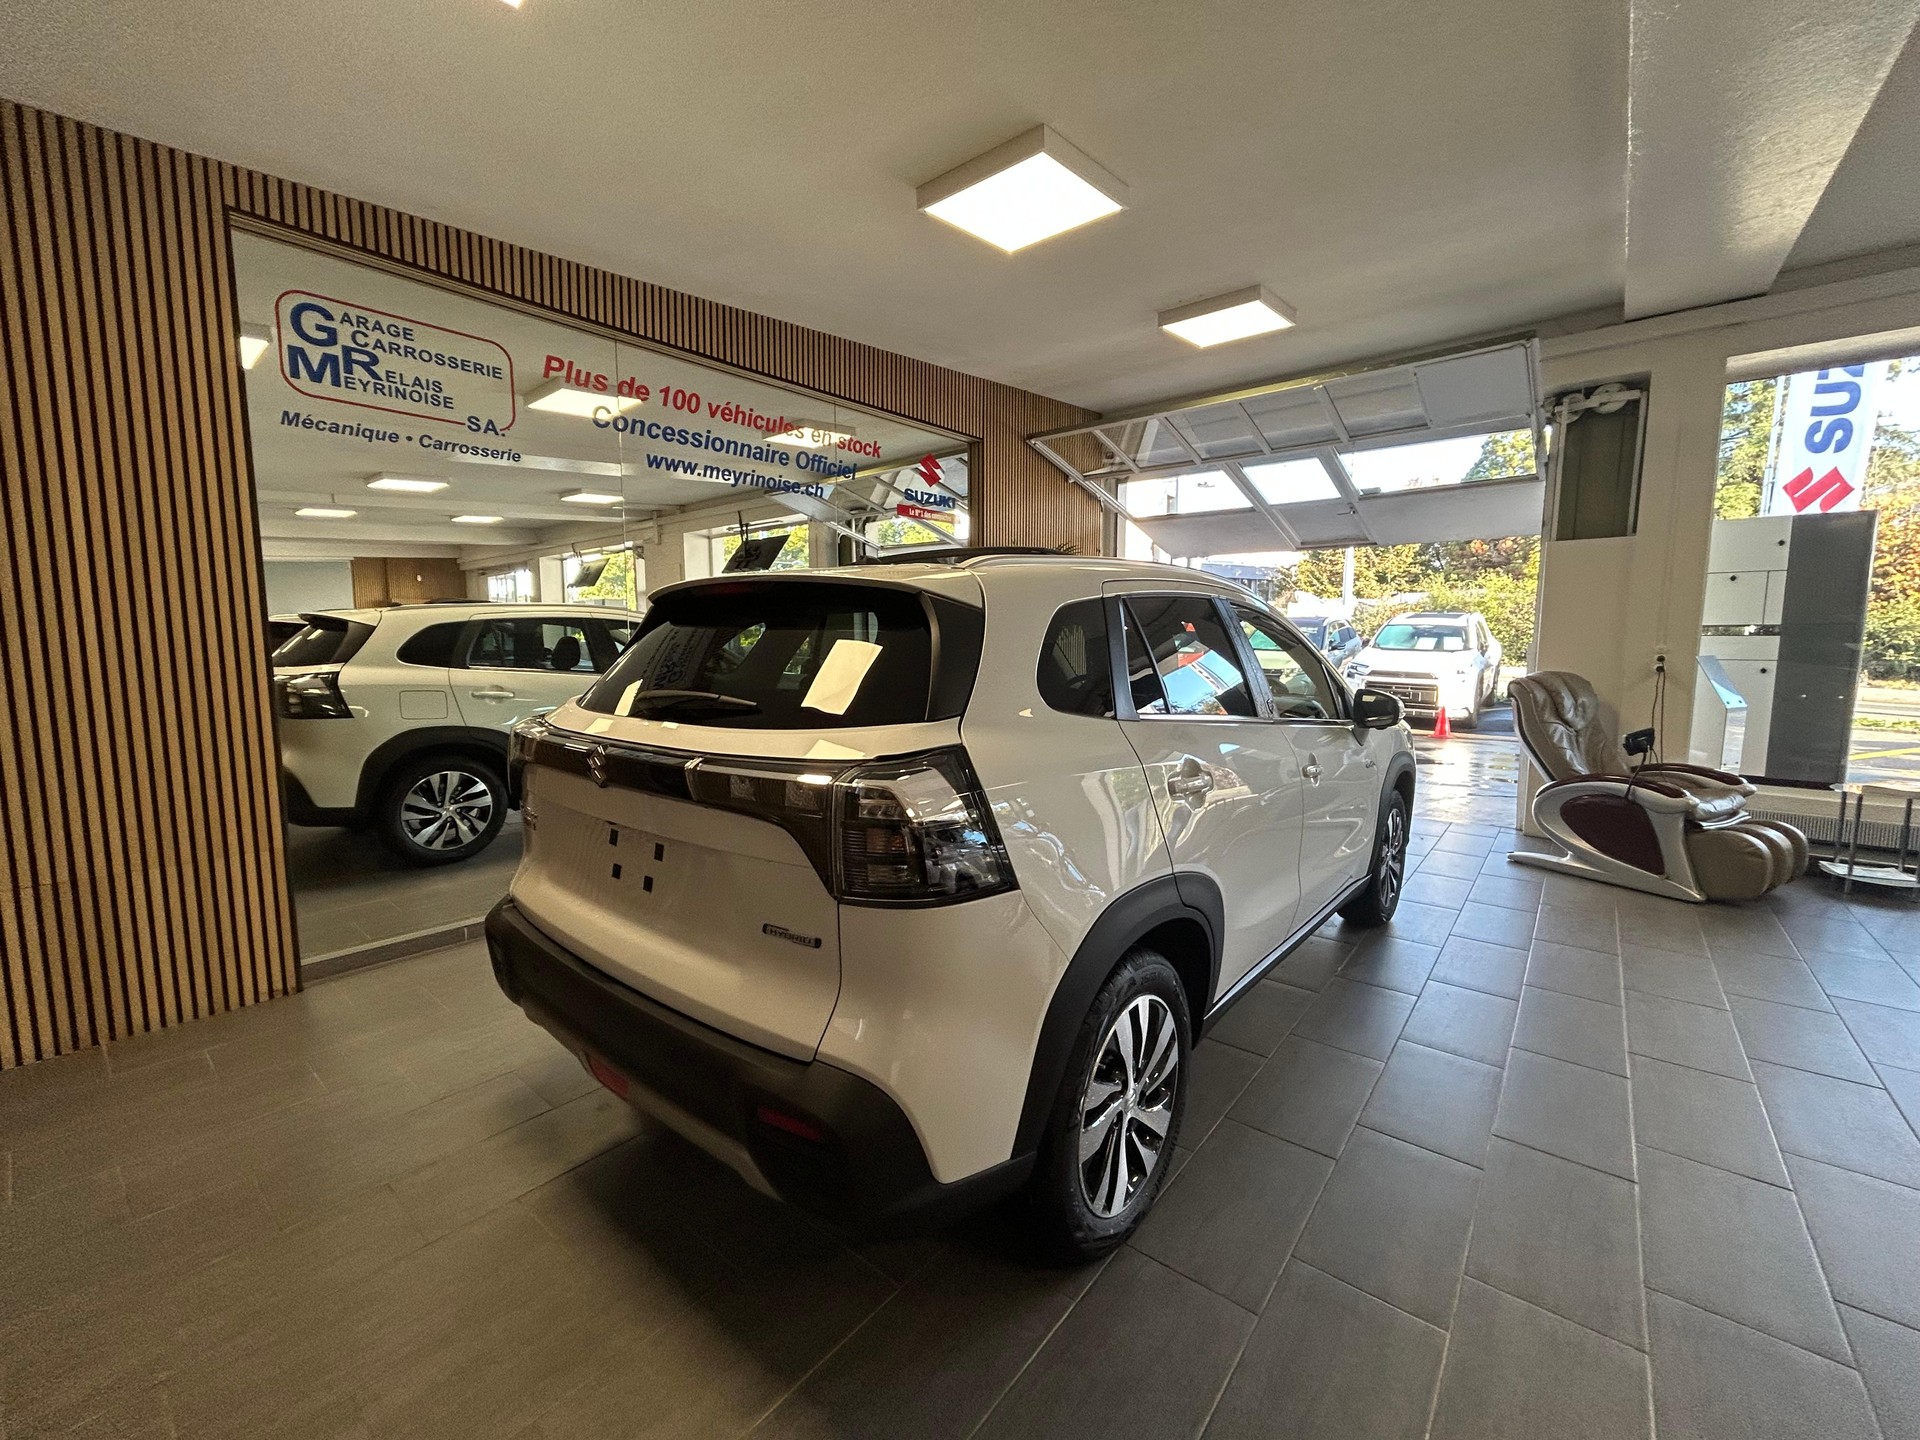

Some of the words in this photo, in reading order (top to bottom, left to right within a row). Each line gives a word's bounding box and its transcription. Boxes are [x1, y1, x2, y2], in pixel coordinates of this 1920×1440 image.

[351, 329, 503, 380] CARROSSERIE
[467, 415, 506, 438] SA.
[543, 354, 609, 392] Plus
[617, 376, 650, 402] de
[659, 385, 701, 414] 100
[707, 401, 805, 439] véhicules
[811, 429, 832, 447] en
[837, 434, 882, 459] stock
[280, 410, 400, 444] Mécanique
[418, 434, 522, 463] Carrosserie
[592, 405, 790, 466] Concessionnaire
[795, 450, 858, 481] Officiel
[646, 453, 824, 499] www.meyrinoise.ch
[904, 488, 956, 508] SUZUKI
